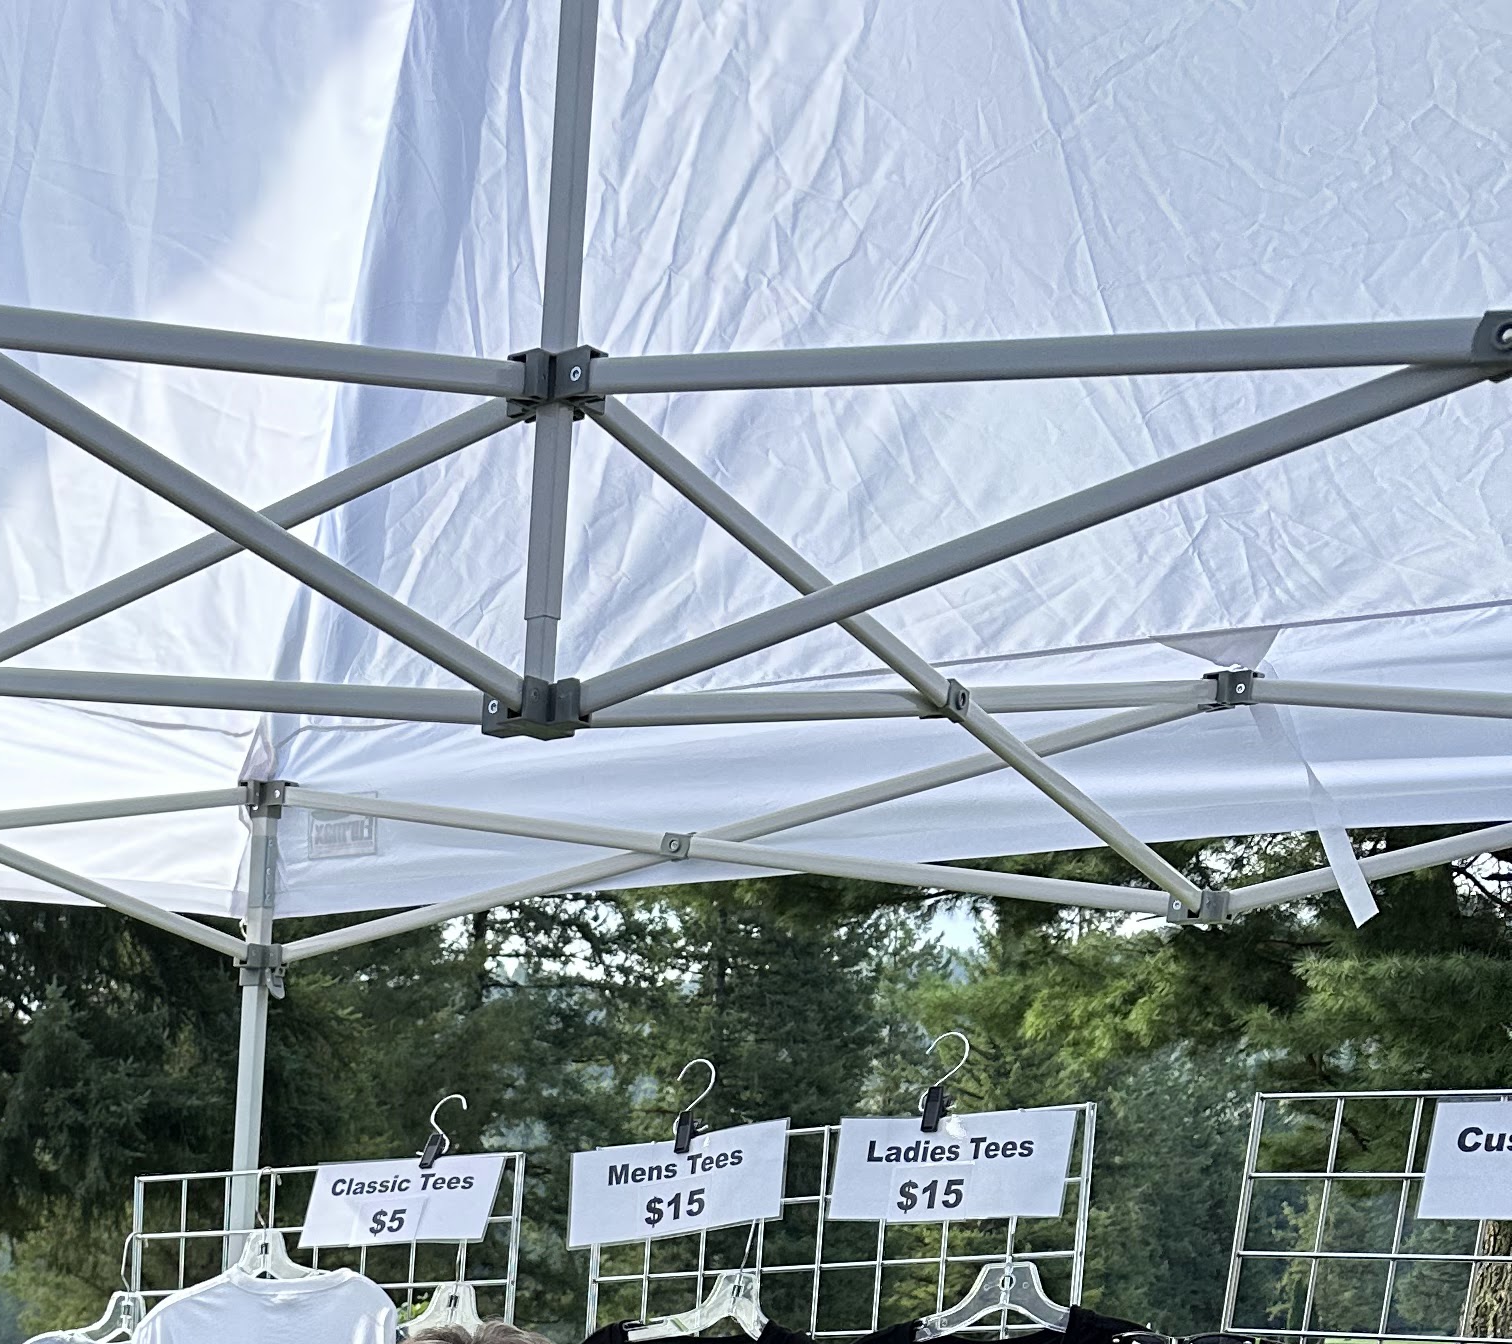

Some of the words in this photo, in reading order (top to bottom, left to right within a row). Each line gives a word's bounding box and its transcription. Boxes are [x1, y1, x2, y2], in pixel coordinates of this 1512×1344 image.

[866, 1139, 960, 1164] Ladies
[969, 1136, 1034, 1160] Tees
[608, 1163, 678, 1186] Mens
[687, 1147, 744, 1174] Tees
[331, 1174, 412, 1197] Classic
[420, 1172, 475, 1191] Tees
[896, 1178, 964, 1213] $15
[369, 1208, 407, 1237] $5
[645, 1188, 705, 1227] $15
